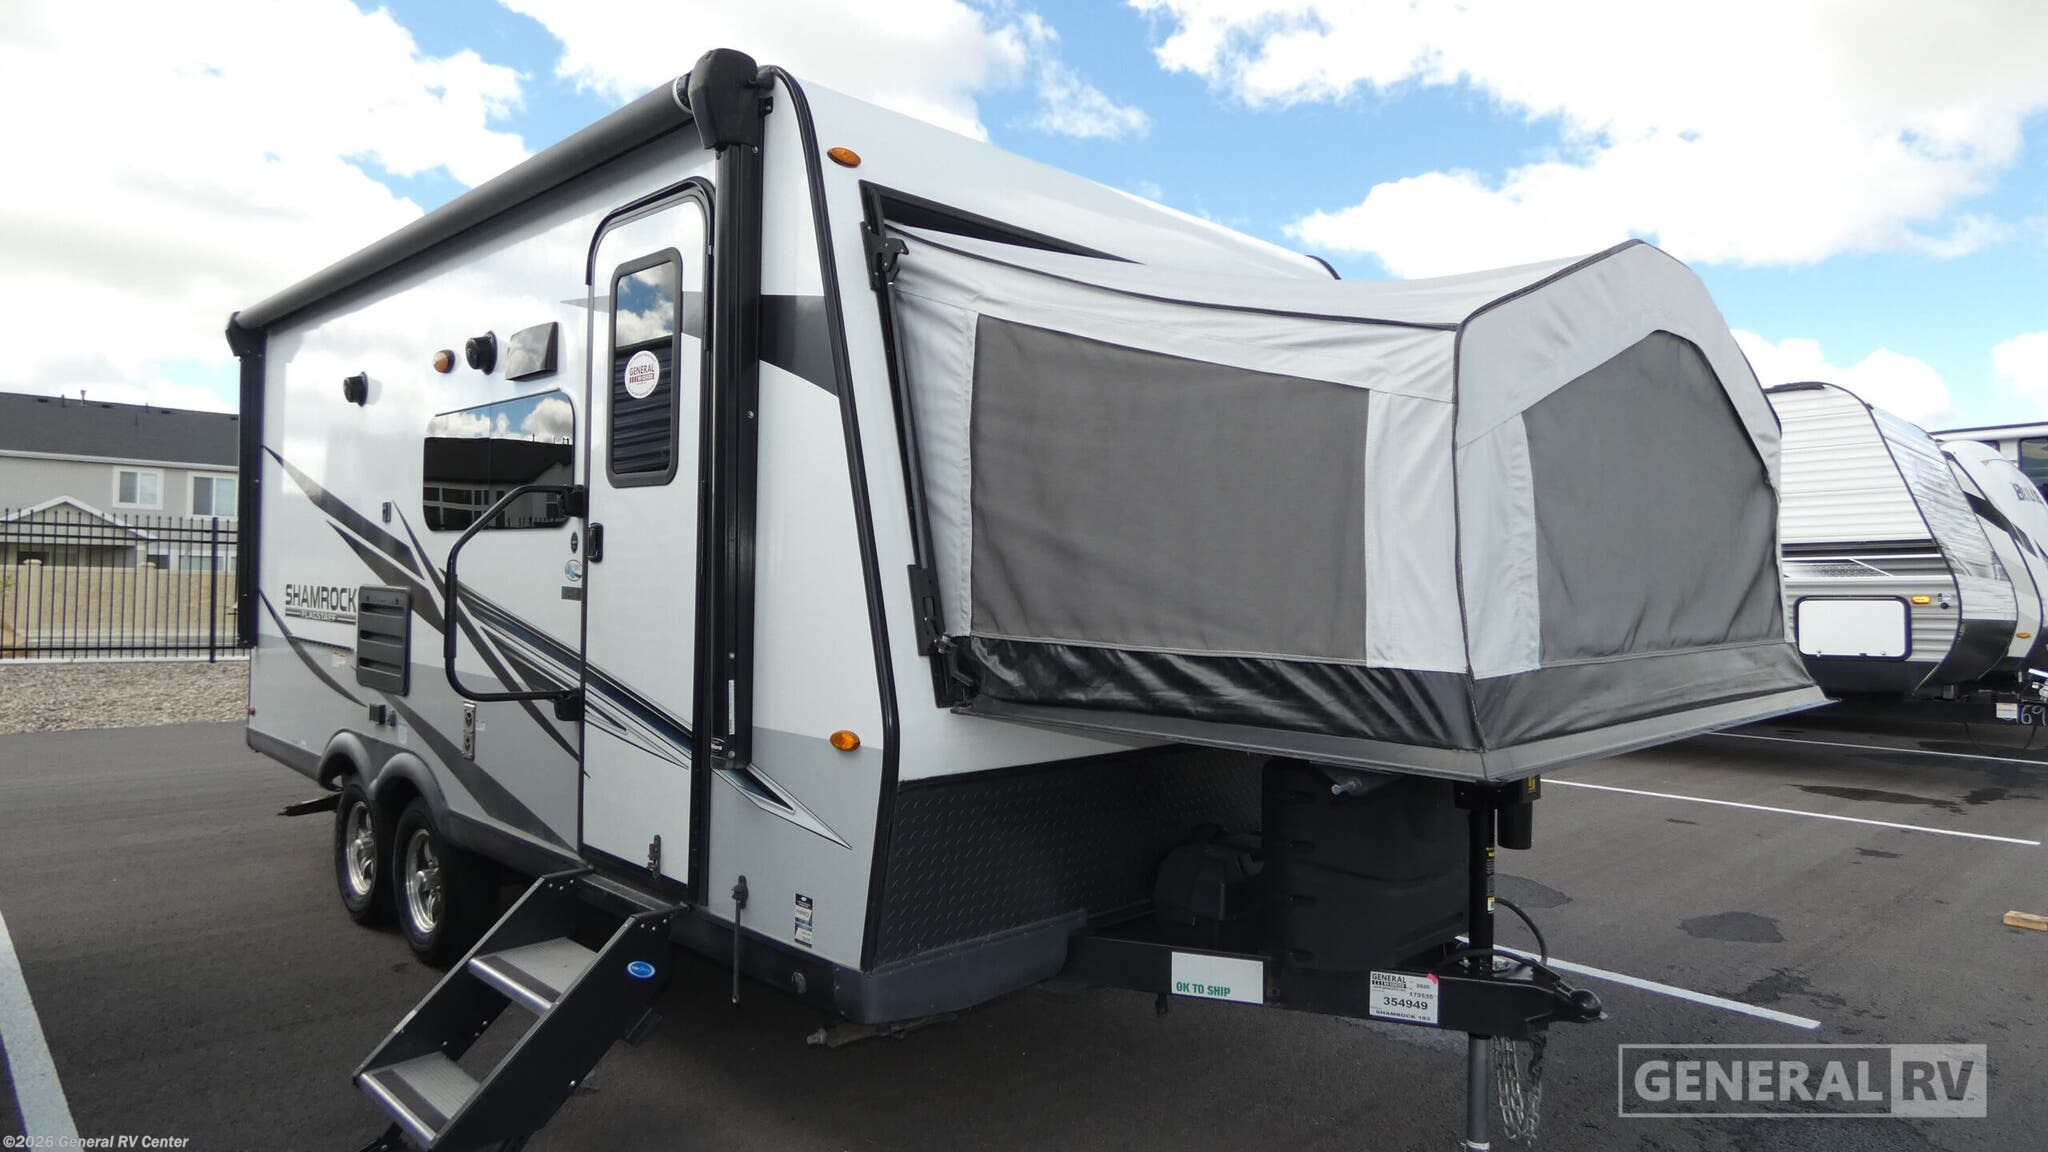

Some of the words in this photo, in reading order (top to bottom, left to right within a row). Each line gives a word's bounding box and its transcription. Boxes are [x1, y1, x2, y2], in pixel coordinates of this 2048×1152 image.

[629, 363, 654, 375] GENERAL
[285, 584, 357, 612] SHAMROCK
[1372, 973, 1407, 983] GENERAL
[1176, 981, 1190, 993] OK
[1192, 983, 1204, 994] TO
[1207, 985, 1231, 997] SHIP
[1383, 997, 1428, 1010] 354949
[1376, 1010, 1416, 1018] SHAMROCK
